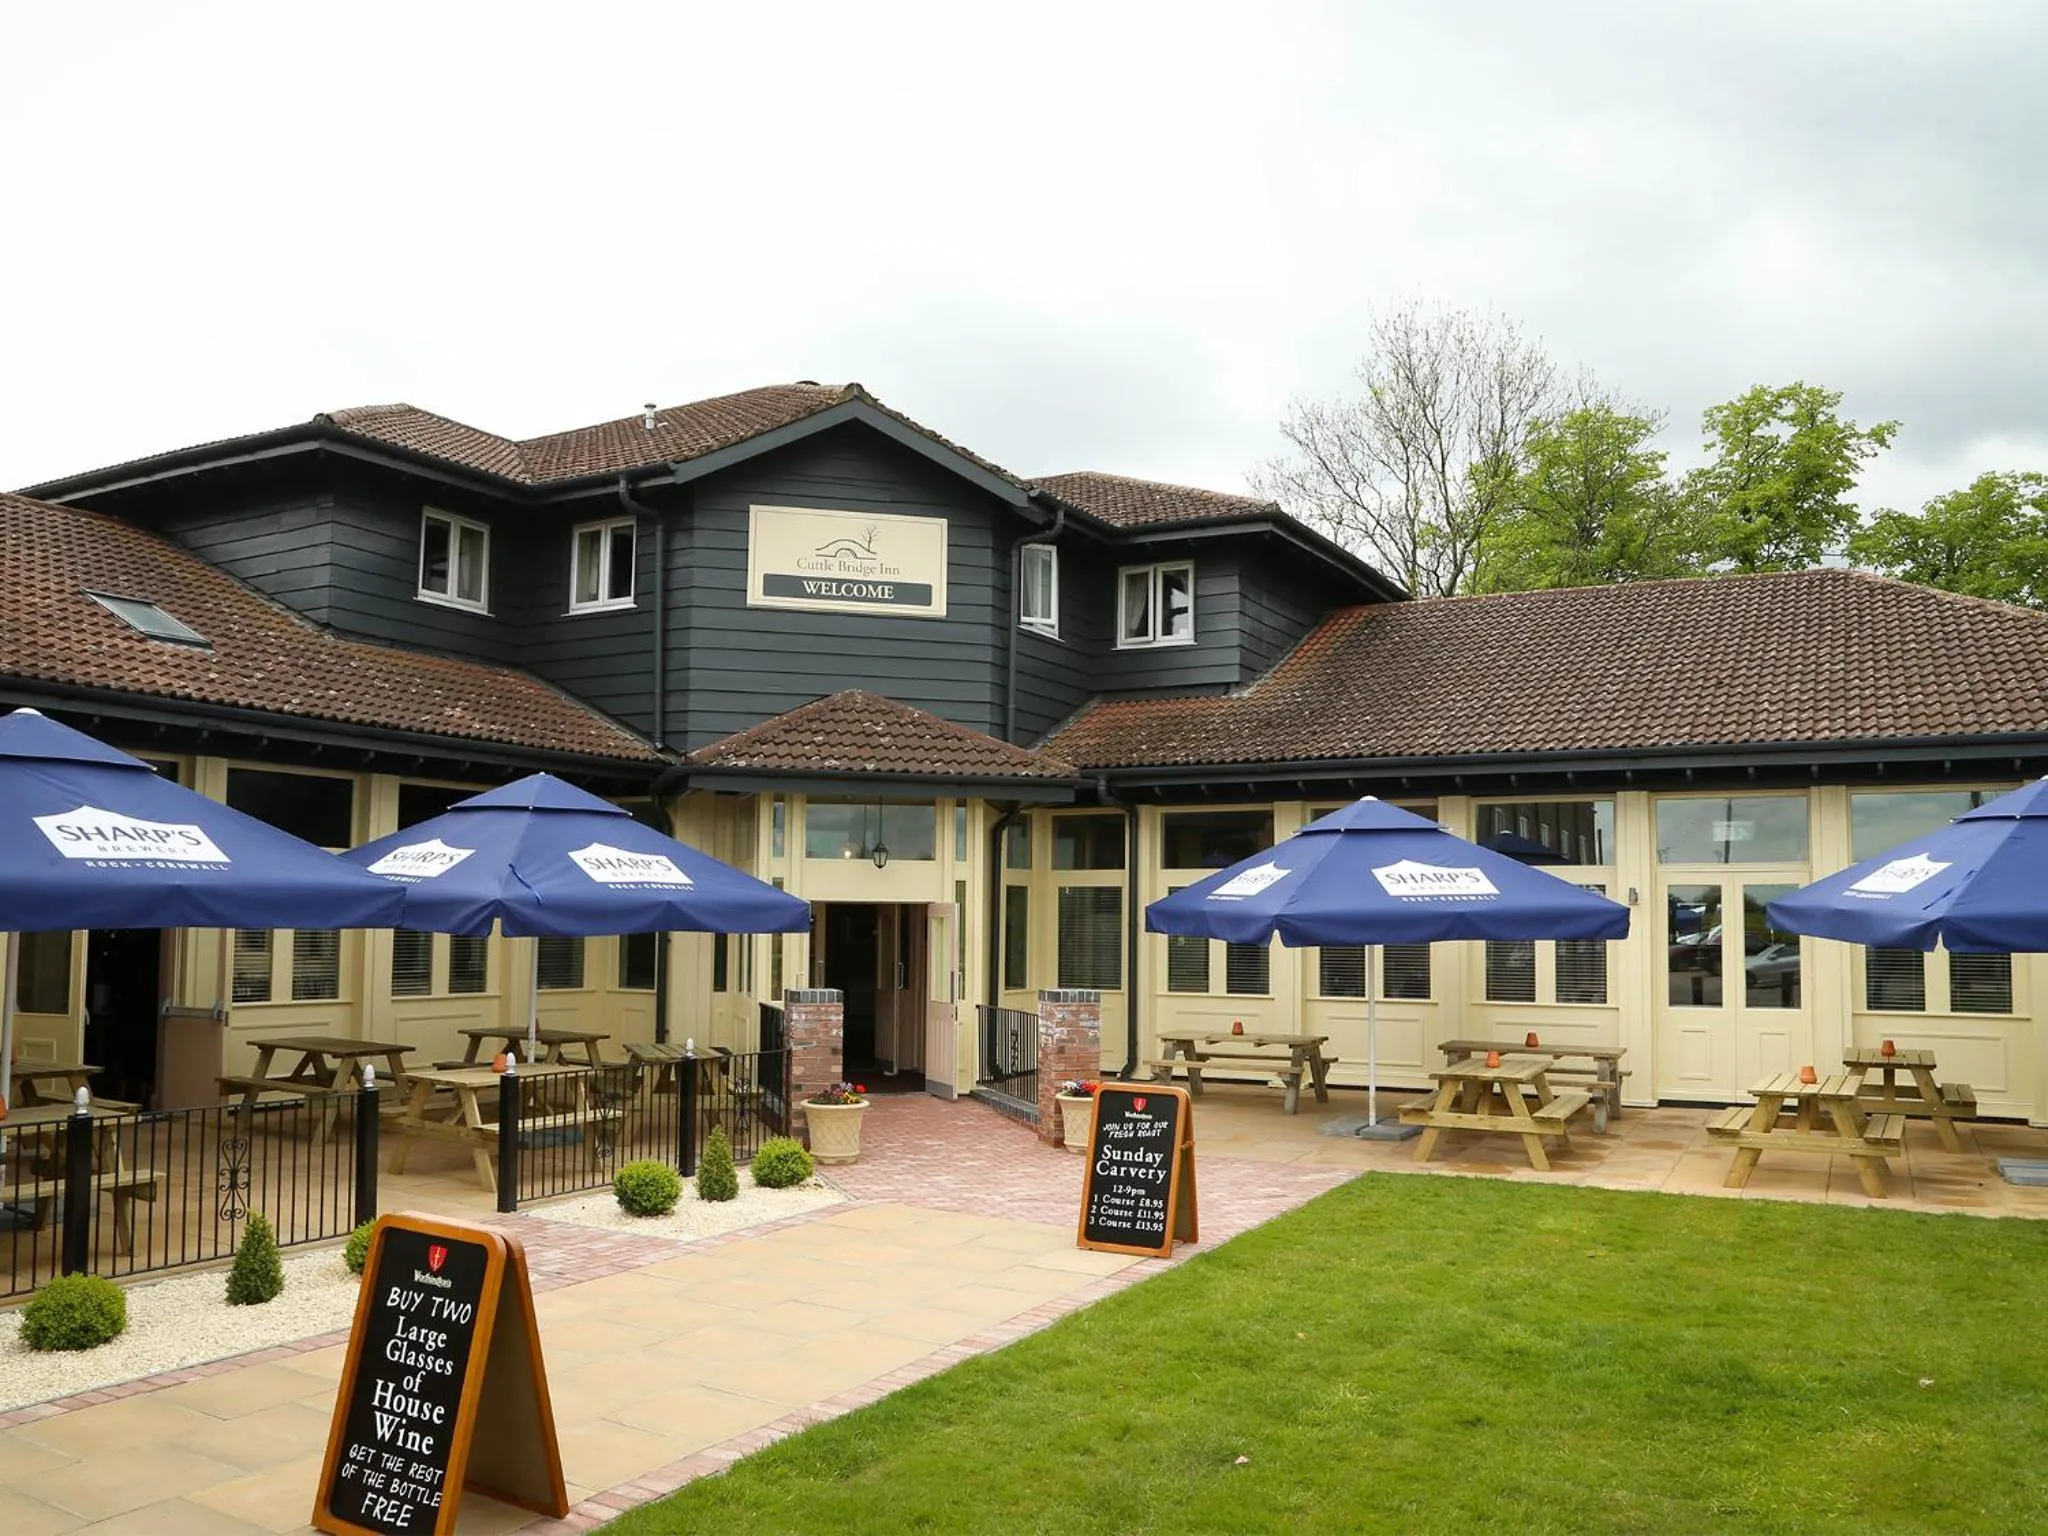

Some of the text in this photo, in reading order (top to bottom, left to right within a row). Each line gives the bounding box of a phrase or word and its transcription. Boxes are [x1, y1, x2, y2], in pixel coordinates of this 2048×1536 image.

[796, 557, 900, 577] Cuttle Bridge Inn
[802, 580, 895, 600] WELCOME
[56, 824, 202, 846] SHARP'S
[583, 857, 673, 872] SHARP'S
[1385, 872, 1481, 885] SHARP'S
[1101, 1144, 1164, 1167] Sunday
[1096, 1161, 1167, 1184] Carvery
[1090, 1205, 1165, 1220] 2 Course £11.95
[1102, 1194, 1135, 1206] Course
[1139, 1198, 1164, 1209] £8.95
[1089, 1216, 1164, 1232] 3 Course £13.95
[387, 1287, 472, 1324] BUY TWO
[395, 1316, 447, 1350] Large
[386, 1339, 453, 1376] Glasses
[403, 1370, 426, 1393] of
[371, 1379, 445, 1425] House
[374, 1411, 434, 1455] Wine
[349, 1443, 443, 1485] GET THE REST
[341, 1462, 443, 1508] OF THE BOTTLE
[361, 1491, 415, 1528] FREE
